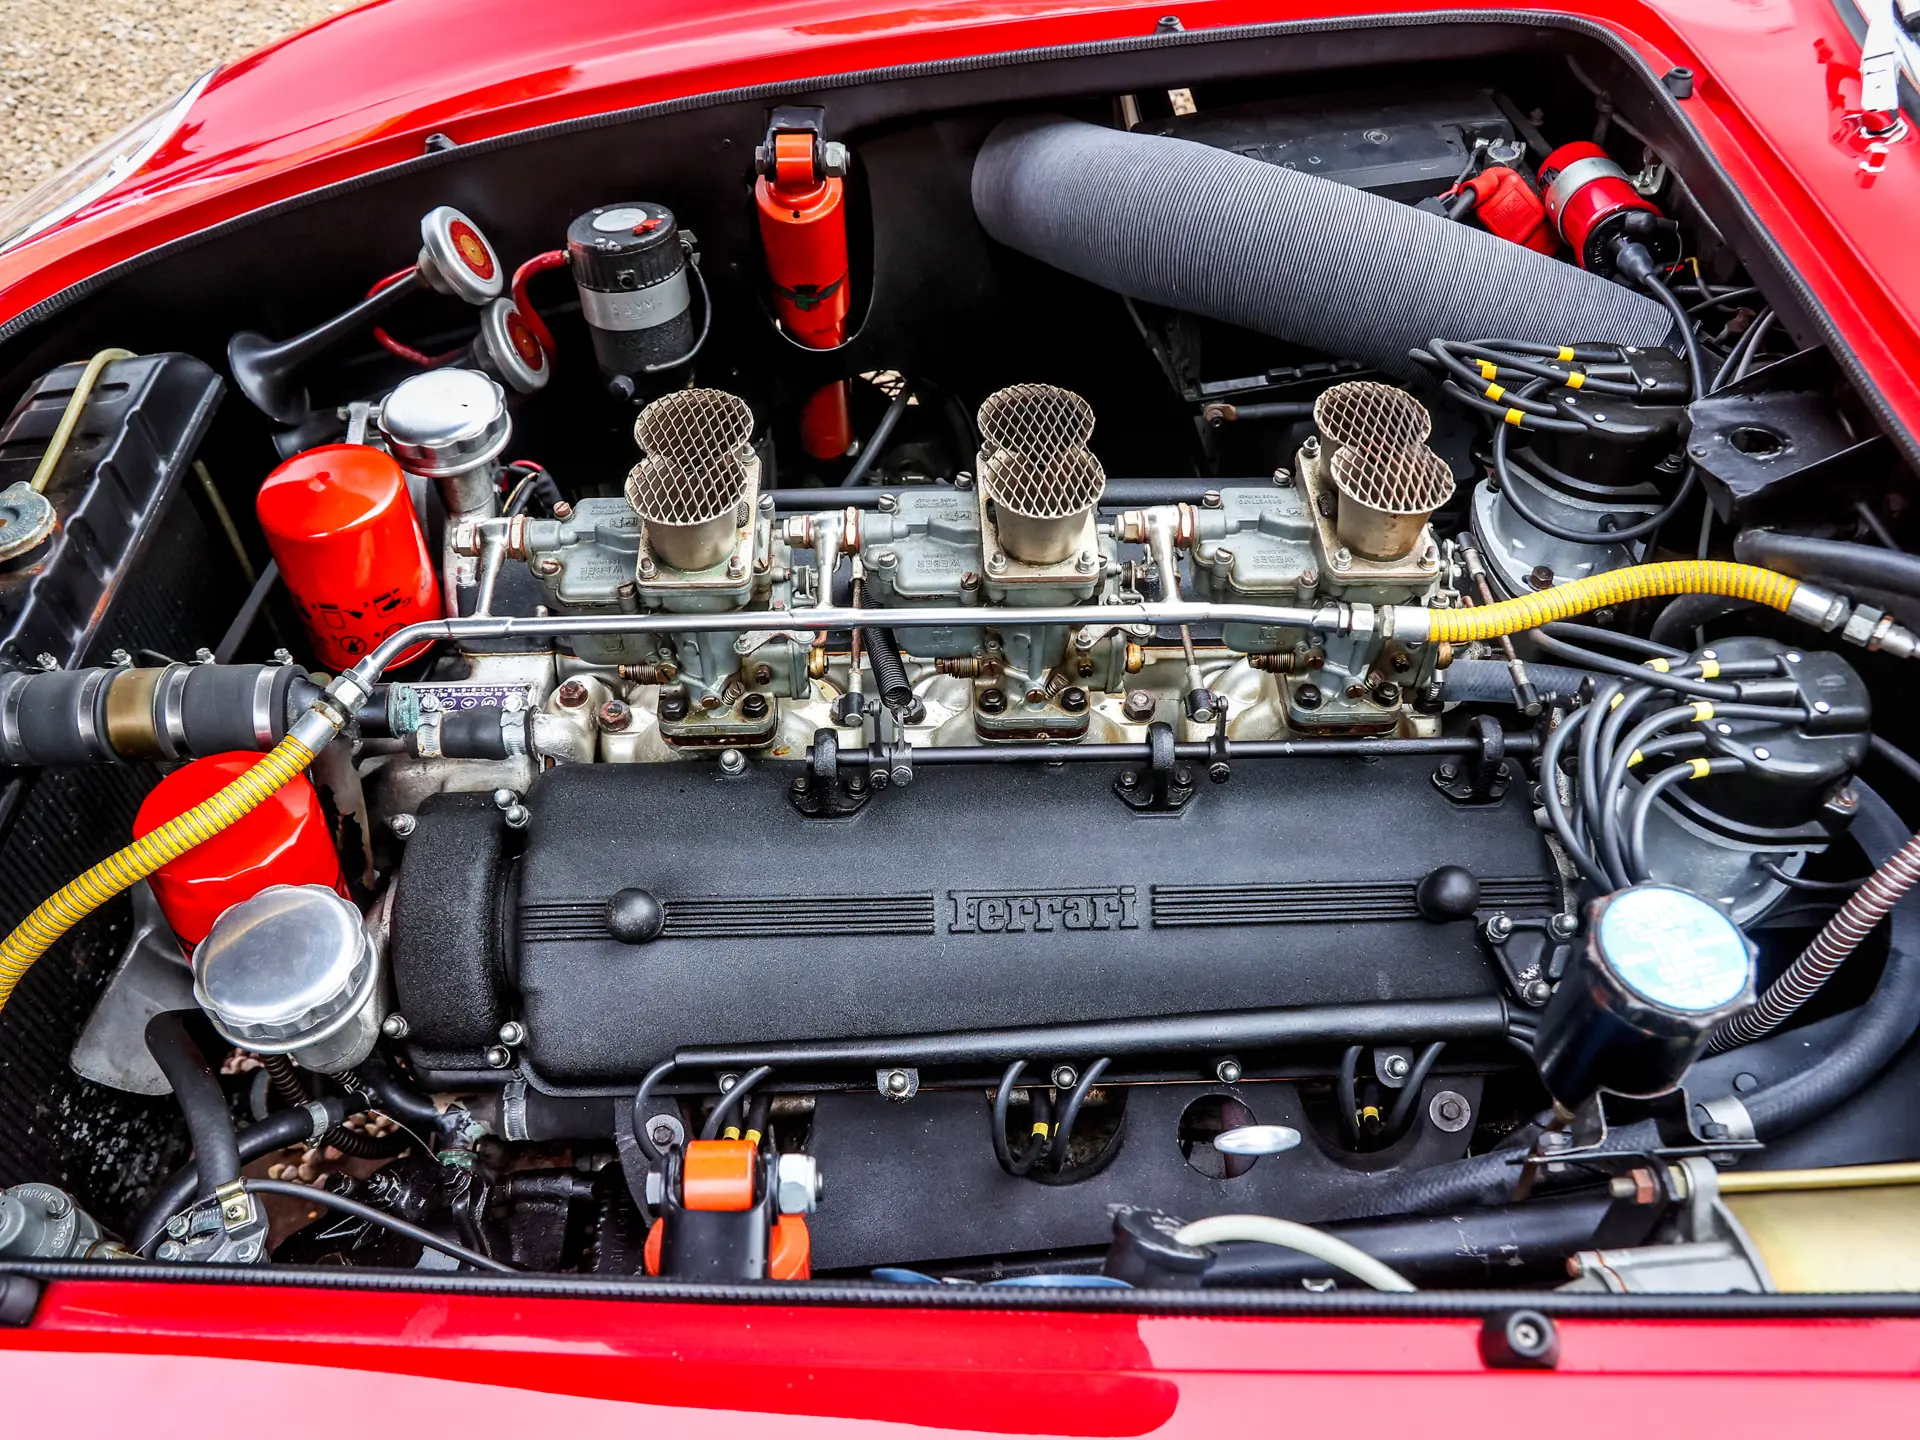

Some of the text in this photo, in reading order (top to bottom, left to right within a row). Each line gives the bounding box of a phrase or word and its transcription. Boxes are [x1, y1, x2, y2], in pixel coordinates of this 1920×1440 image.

[917, 559, 961, 568] WEBER
[580, 565, 623, 575] WEBER
[948, 885, 1138, 933] Ferrari
